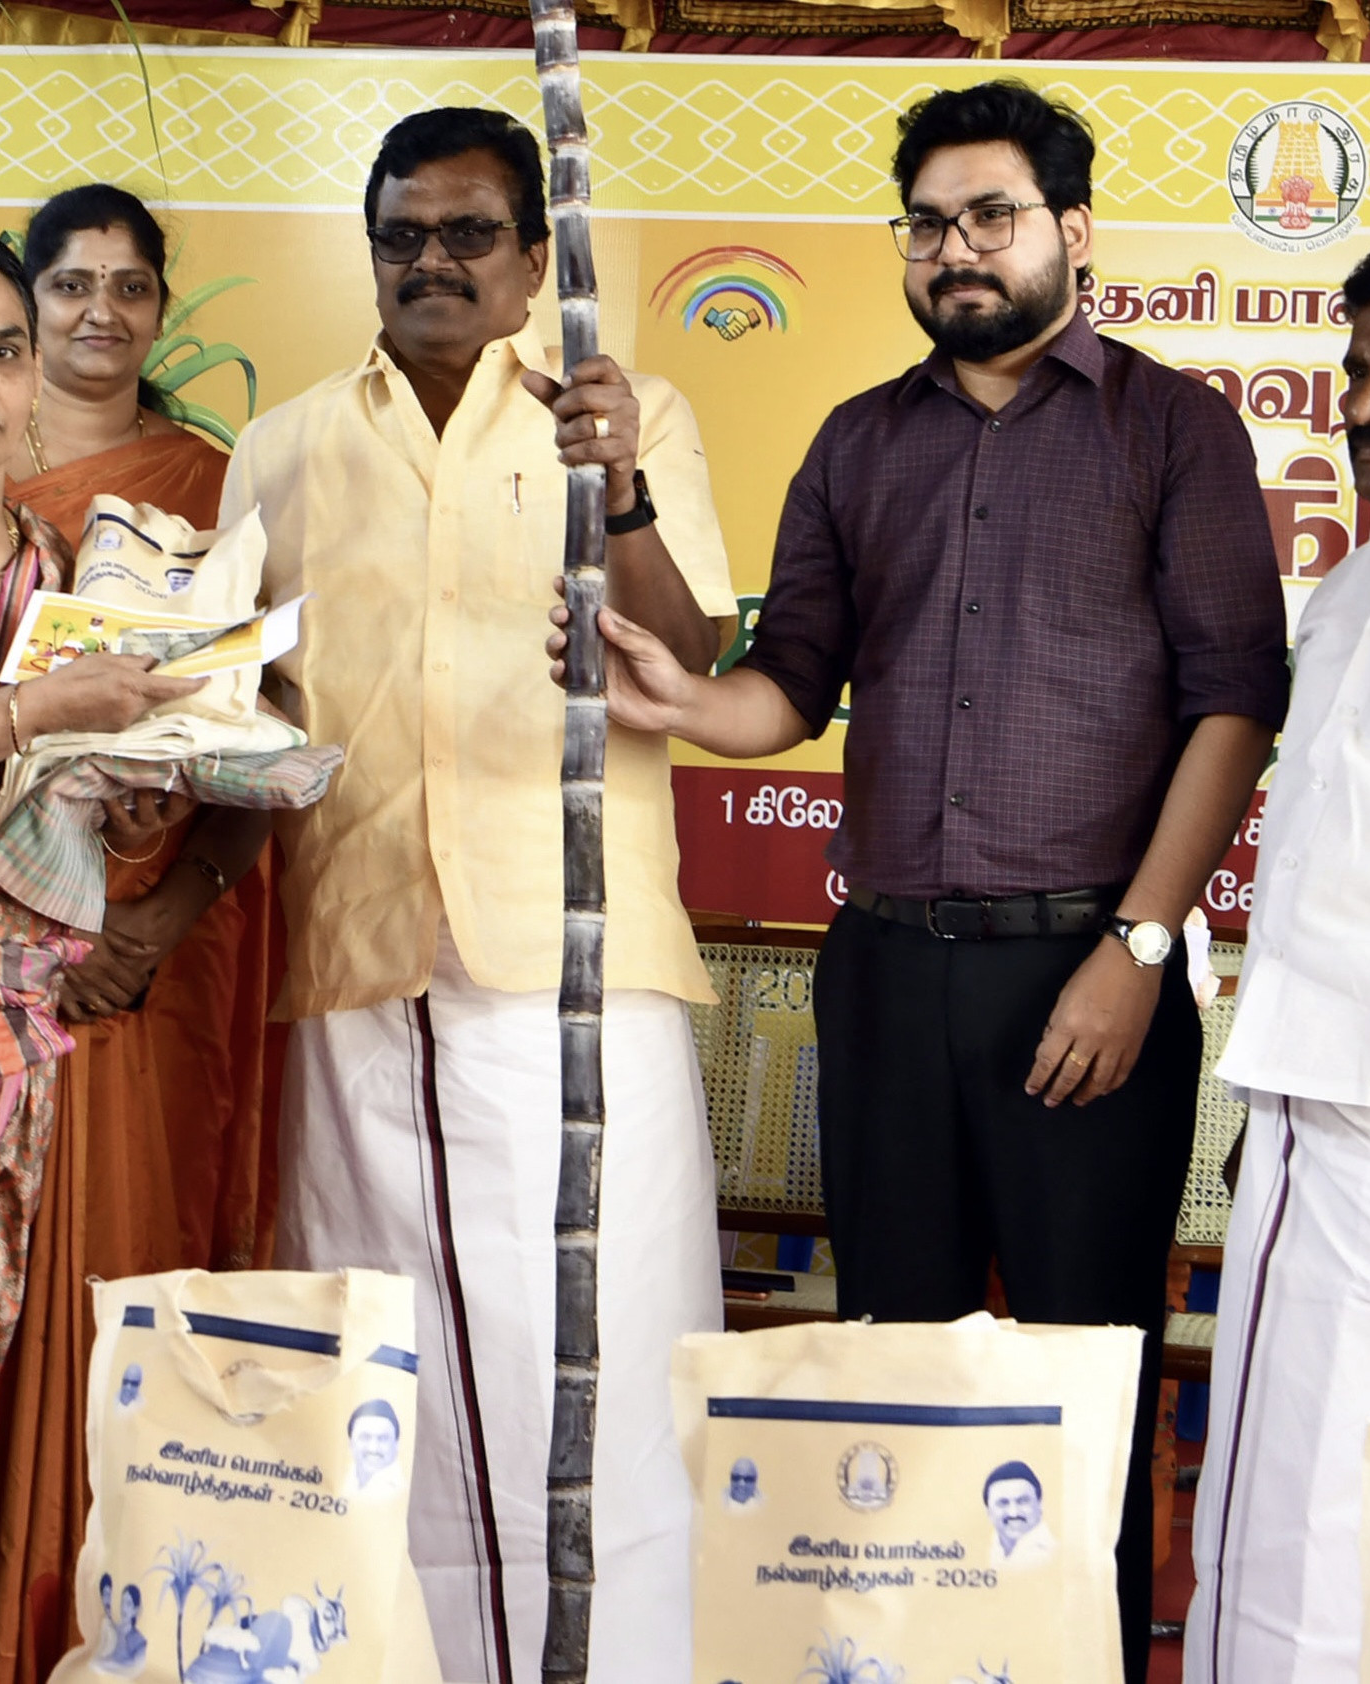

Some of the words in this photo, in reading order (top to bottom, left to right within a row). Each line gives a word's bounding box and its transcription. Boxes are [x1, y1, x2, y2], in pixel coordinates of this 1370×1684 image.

[1335, 126, 1360, 193] அரசு
[721, 790, 733, 824] 1
[159, 1440, 227, 1469] இனிய
[230, 1455, 323, 1486] பொங்கல்
[126, 1463, 273, 1505] நல்வாழ்த்துகள்
[289, 1490, 349, 1517] 2026
[788, 1535, 859, 1560] இனிய
[864, 1540, 966, 1561] பொங்கல்
[935, 1568, 999, 1588] 2026
